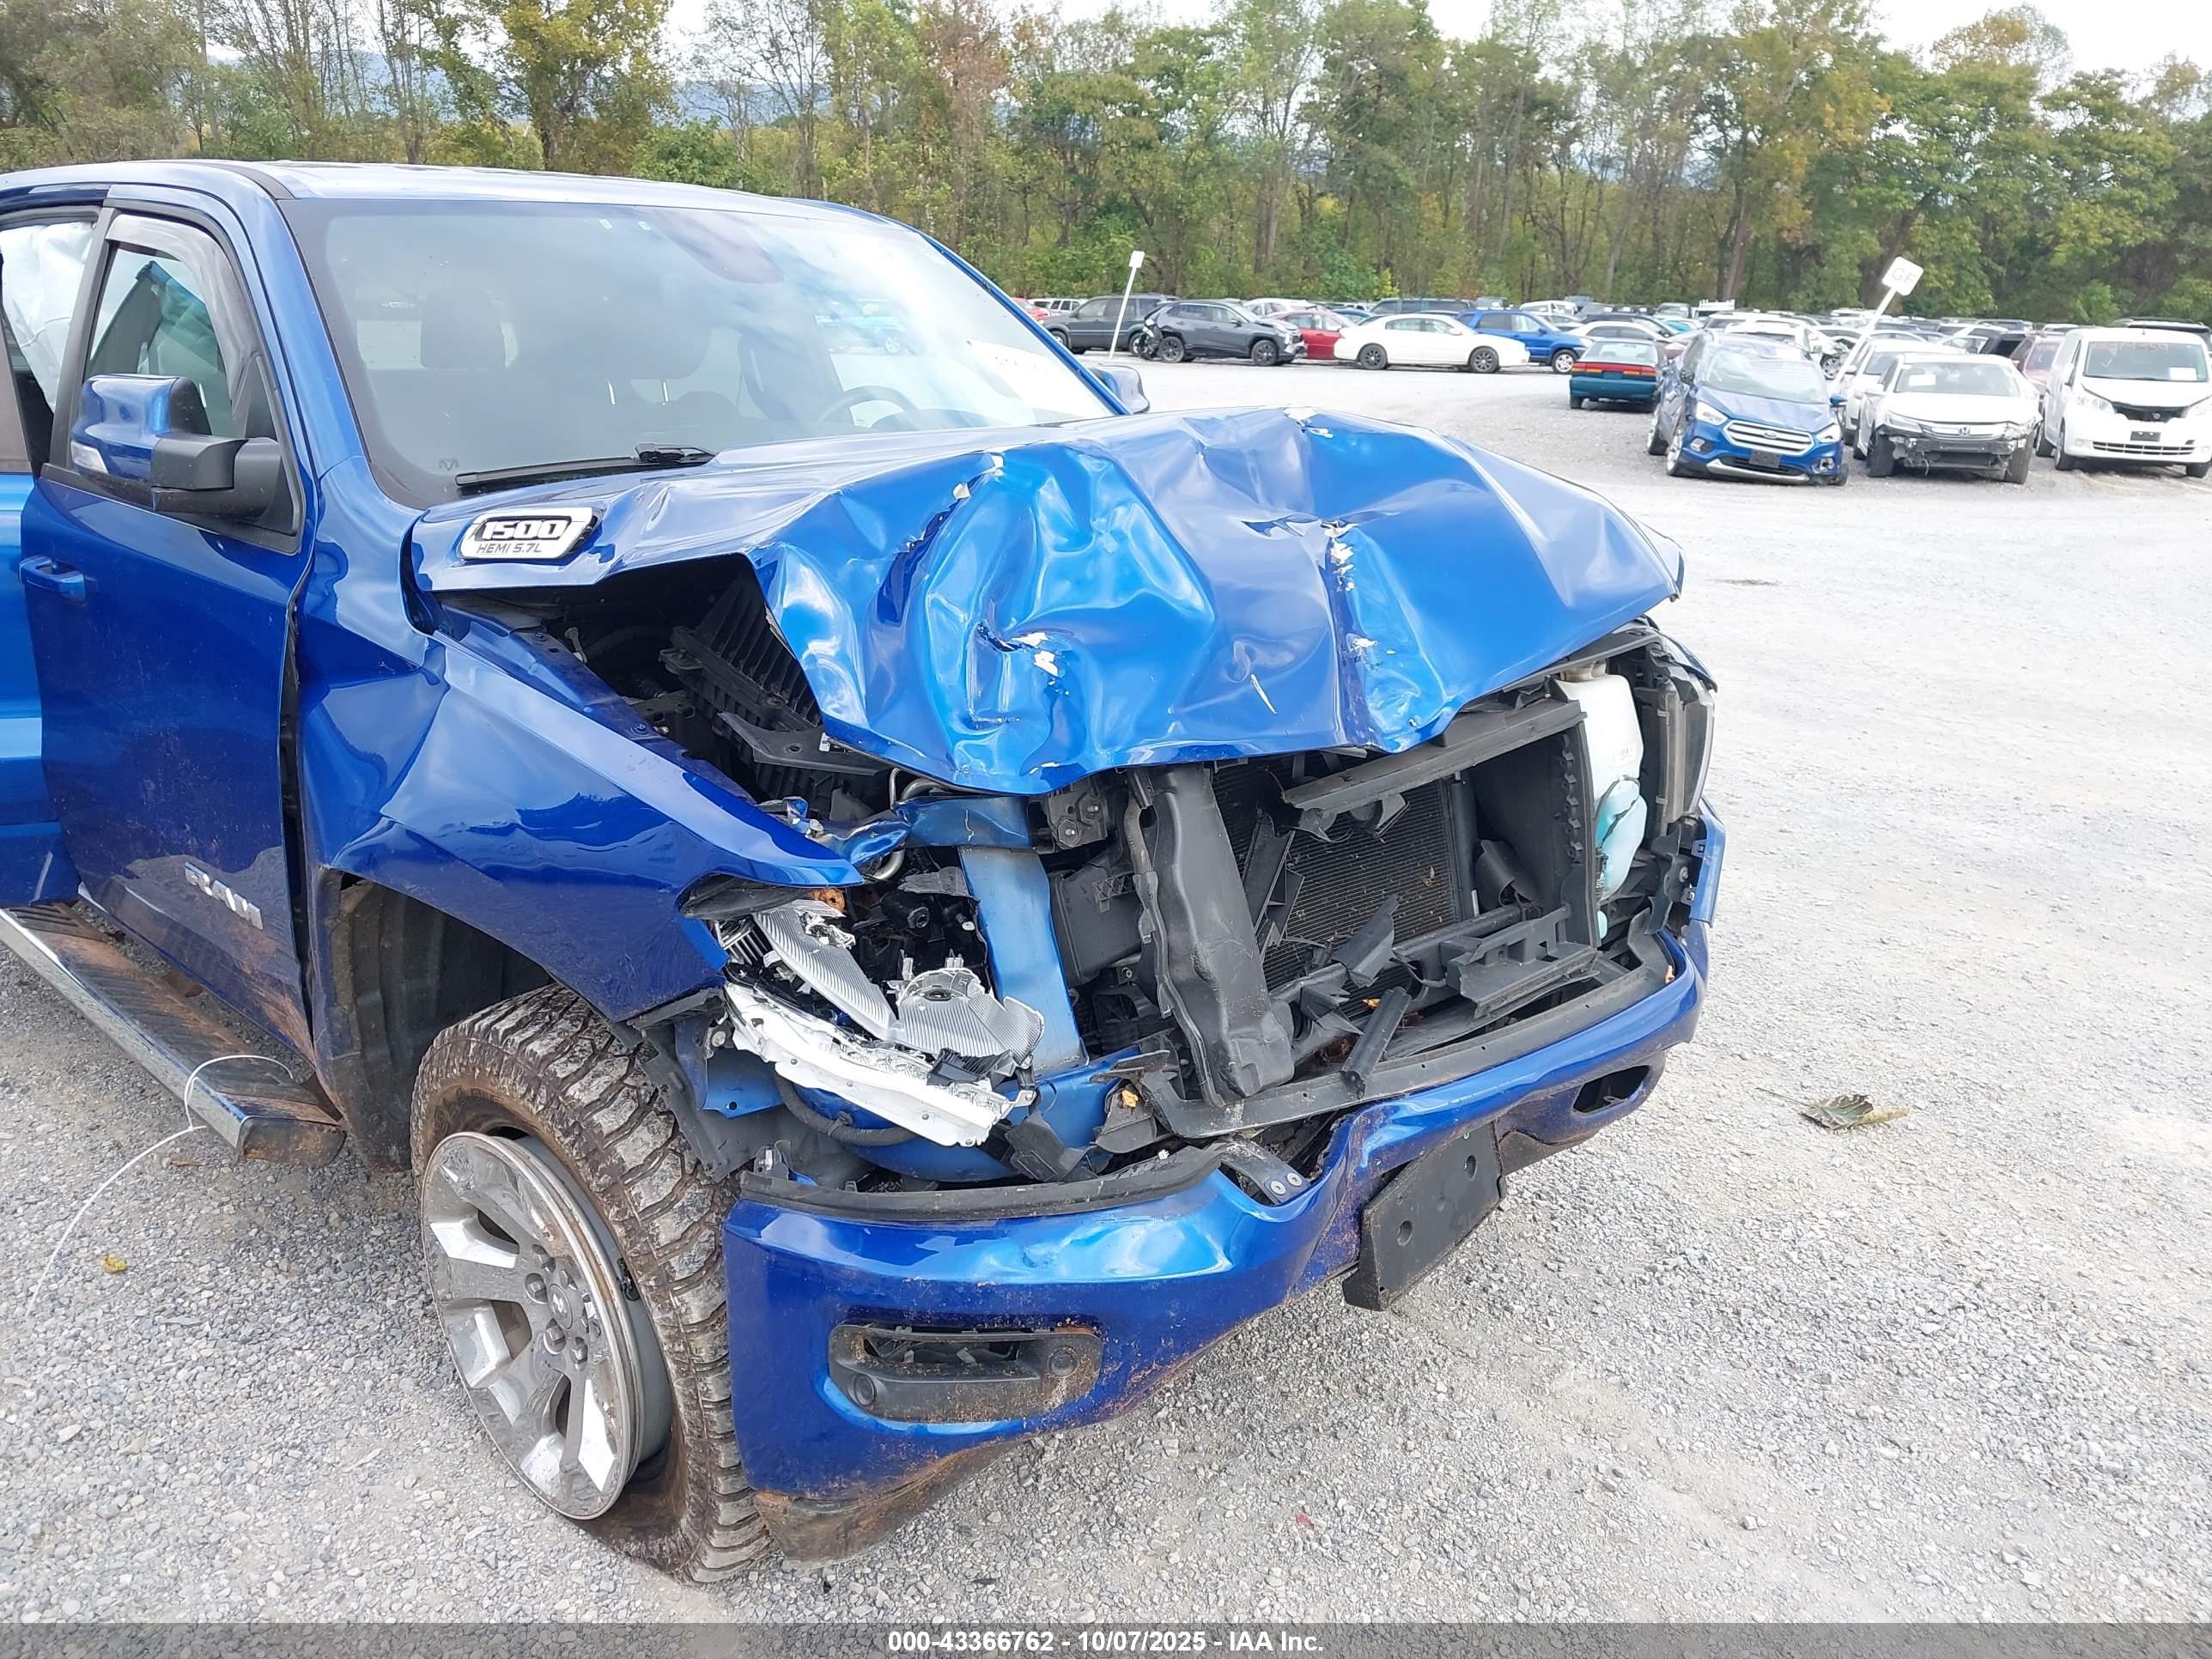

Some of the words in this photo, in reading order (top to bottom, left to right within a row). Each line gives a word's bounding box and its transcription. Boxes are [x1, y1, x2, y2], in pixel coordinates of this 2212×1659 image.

[482, 518, 569, 540] 1500
[477, 543, 510, 554] HEMI
[513, 543, 542, 554] 5.7L
[184, 861, 264, 931] RAM
